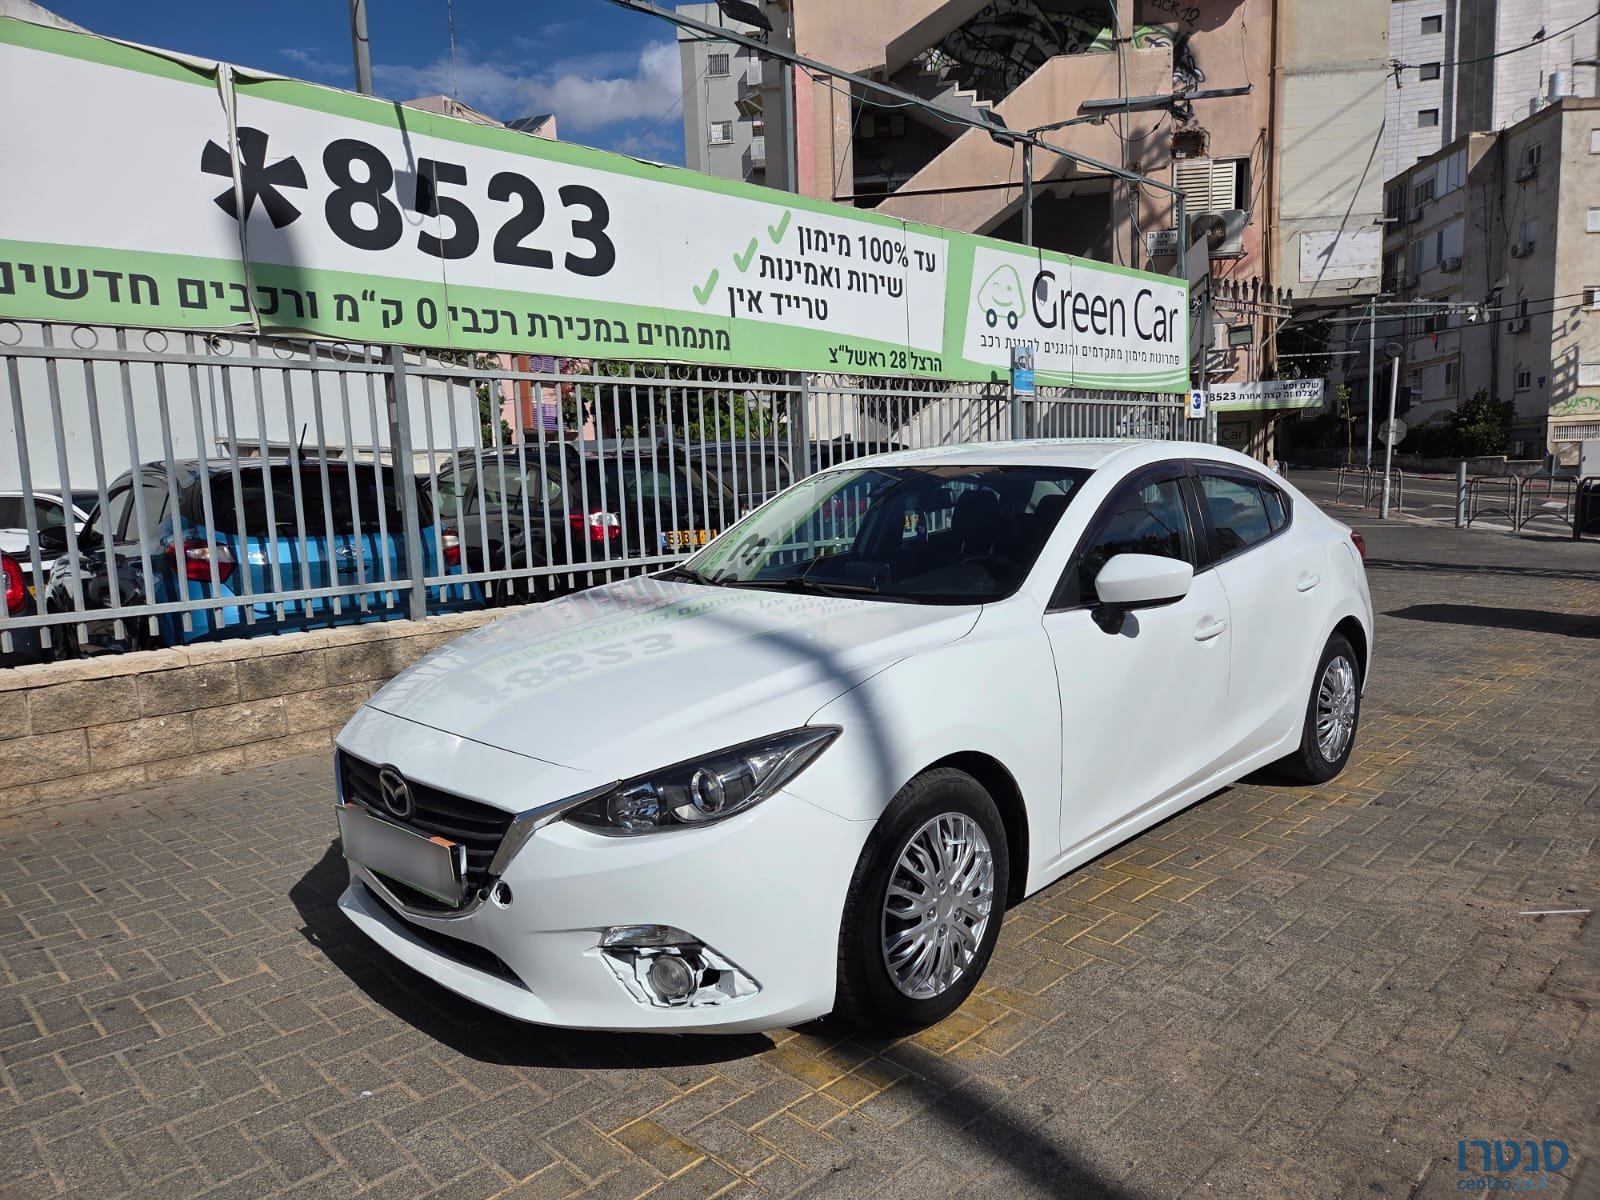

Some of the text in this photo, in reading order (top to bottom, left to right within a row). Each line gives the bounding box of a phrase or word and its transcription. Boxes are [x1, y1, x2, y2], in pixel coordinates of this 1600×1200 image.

[797, 226, 936, 272] עד 100% מימון
[759, 254, 903, 298] שירות ואמינות
[177, 277, 319, 320] ורכבים
[416, 297, 438, 330] 0
[727, 286, 828, 321] טרייד אין
[1032, 270, 1179, 344] Green Car
[448, 305, 518, 336] רכבי
[528, 312, 630, 345] במכירת
[636, 321, 731, 351] מתמחים
[980, 334, 1000, 349] רכב
[828, 344, 942, 372] הרצל 28 ראשל"צ
[1082, 345, 1122, 361] מתקדמים
[1125, 350, 1147, 363] מימון
[1149, 353, 1180, 366] פתרונות
[1209, 391, 1236, 402] 8523
[1264, 392, 1281, 400] קצת
[1300, 380, 1319, 389] שלם
